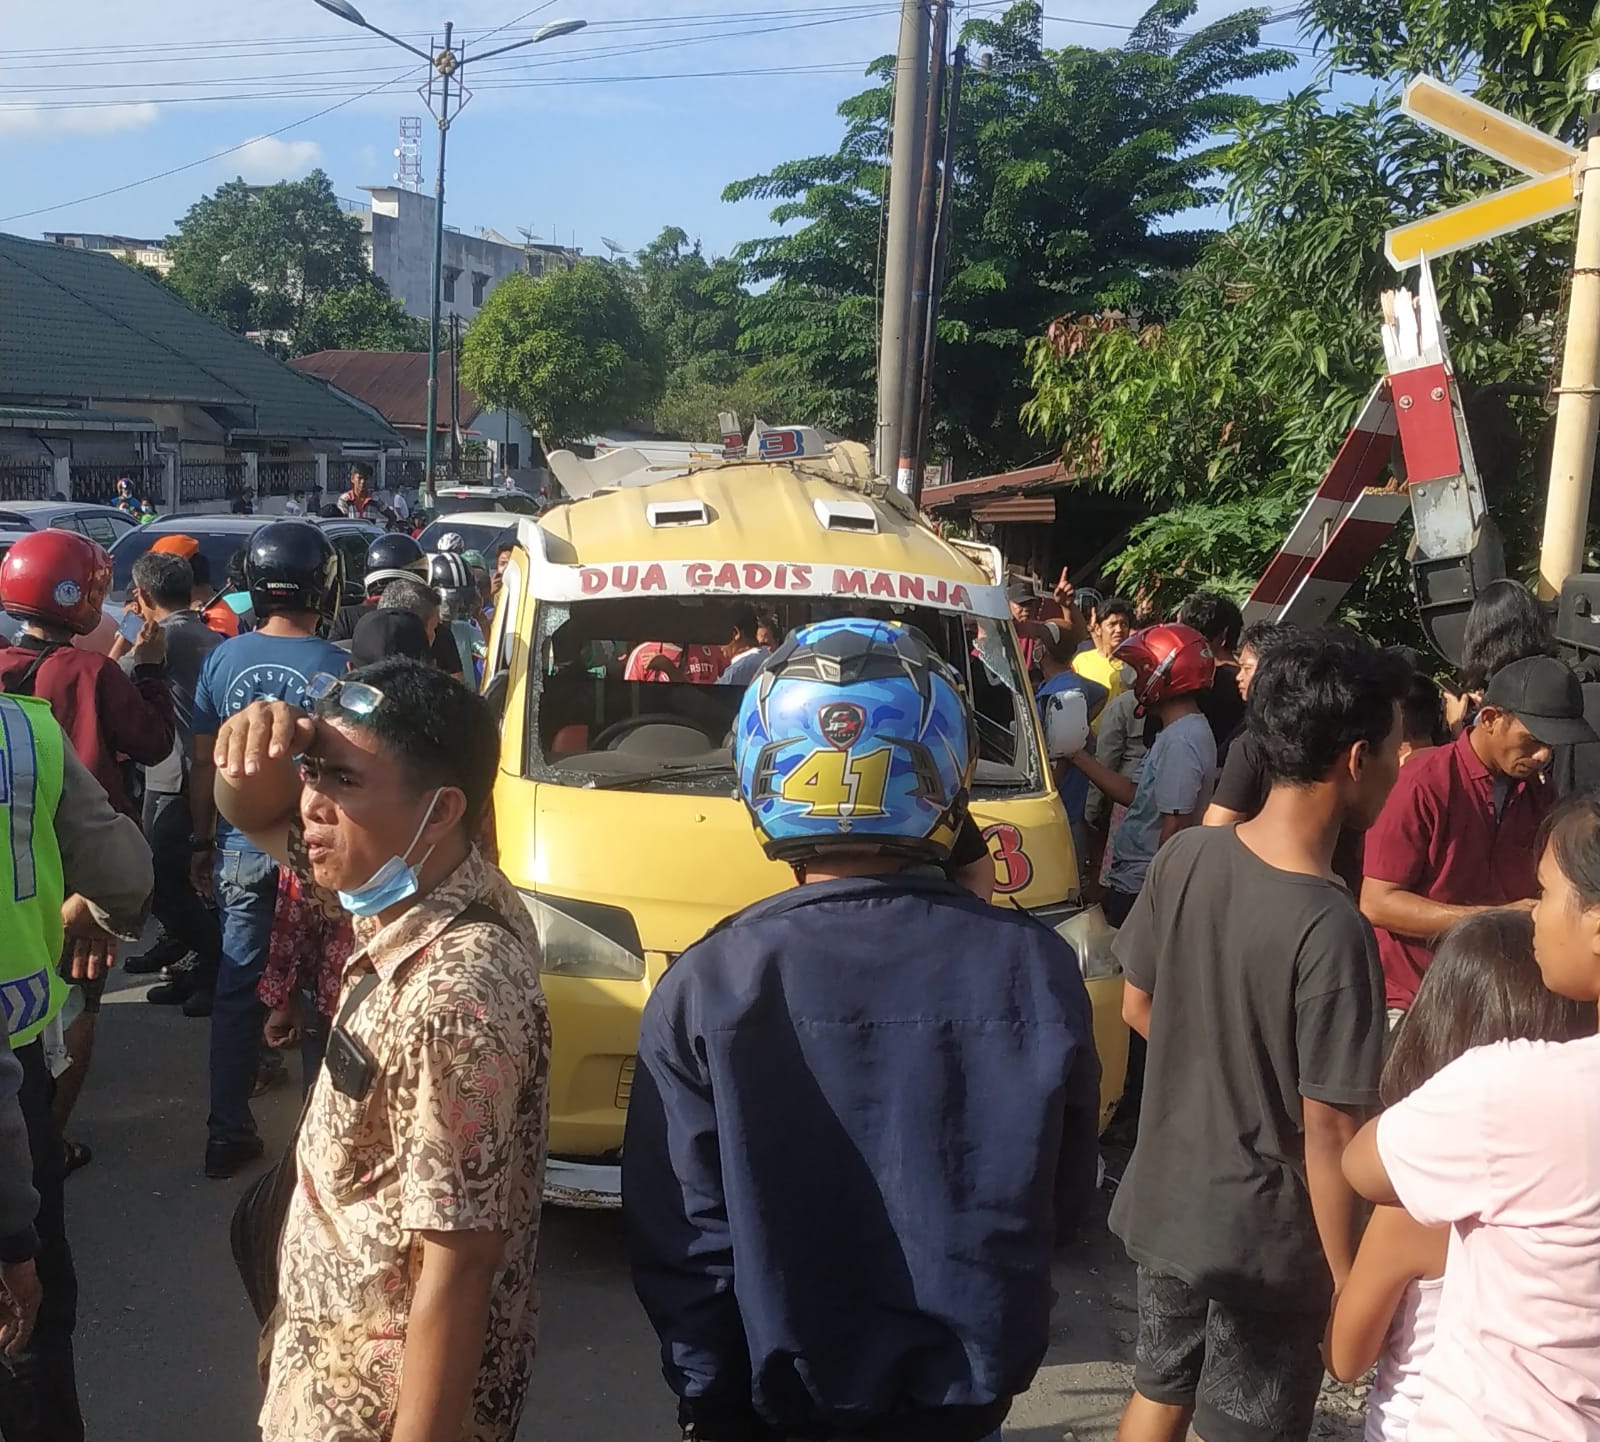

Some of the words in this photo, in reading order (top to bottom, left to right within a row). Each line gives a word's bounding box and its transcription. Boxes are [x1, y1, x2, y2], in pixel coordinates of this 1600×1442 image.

[267, 582, 300, 590] HONDA
[579, 563, 668, 595] DUA
[686, 562, 812, 591] GADIS
[832, 568, 973, 610] MANJA
[781, 747, 894, 818] 41
